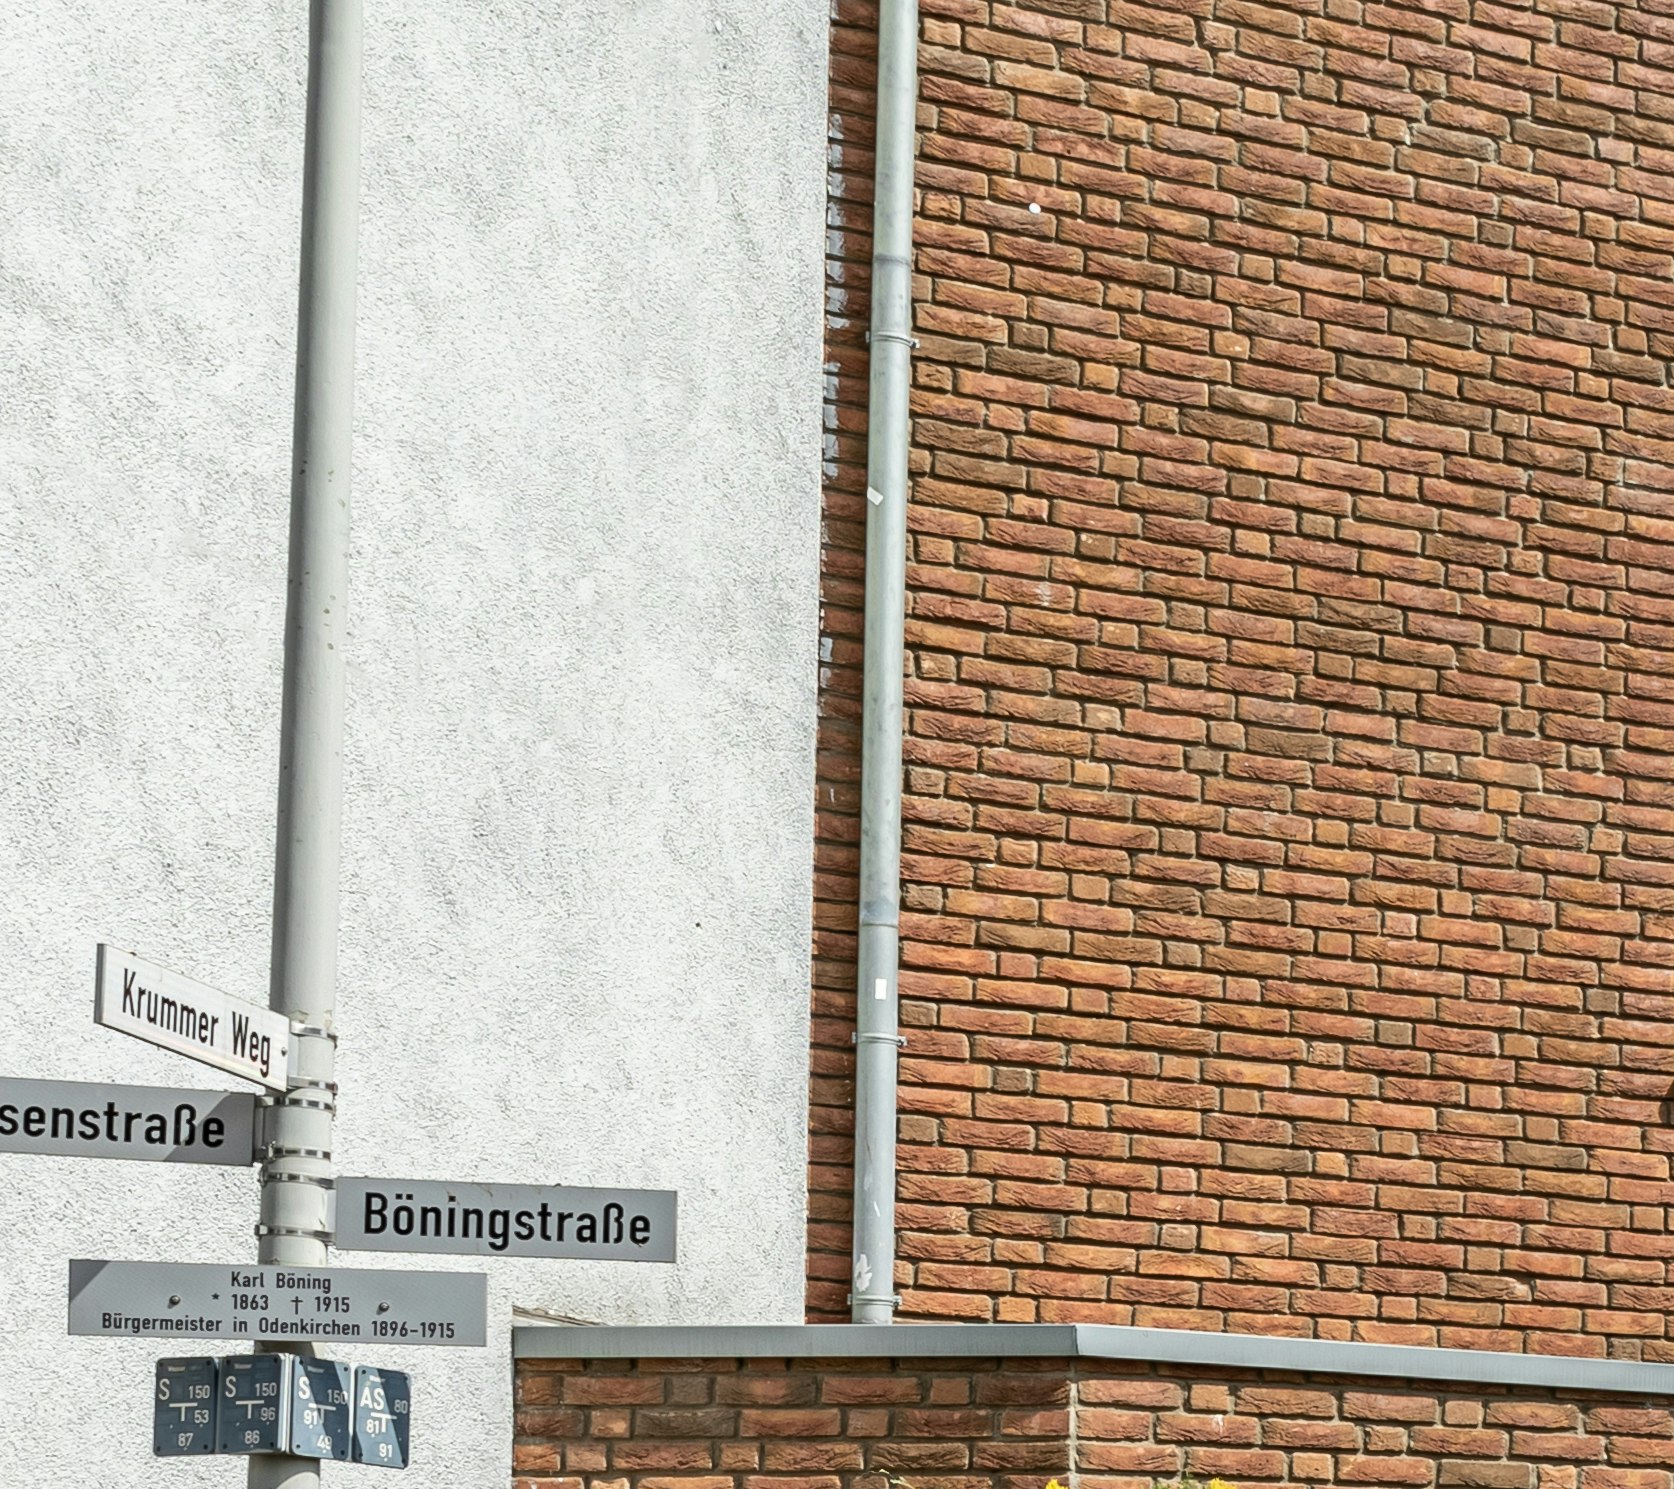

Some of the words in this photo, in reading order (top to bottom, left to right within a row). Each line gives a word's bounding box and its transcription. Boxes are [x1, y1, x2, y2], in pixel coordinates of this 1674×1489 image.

[122, 967, 219, 1047] Krummer
[232, 1011, 271, 1078] Weg
[0, 1102, 225, 1148] senstraße
[364, 1192, 651, 1252] Böningstraße
[231, 1271, 265, 1288] Karl
[276, 1272, 331, 1294] Böning
[231, 1293, 269, 1310] 1863
[315, 1296, 350, 1313] 1915
[102, 1312, 222, 1334] Bürgermeister
[233, 1316, 248, 1332] in
[259, 1316, 360, 1336] Odenkirchen
[158, 1378, 170, 1400] S
[188, 1384, 211, 1399] 150
[225, 1375, 236, 1398] S
[255, 1382, 277, 1397] 150
[298, 1376, 310, 1400] S
[327, 1389, 348, 1405] 150
[360, 1387, 385, 1410] AS
[394, 1399, 409, 1414] 80
